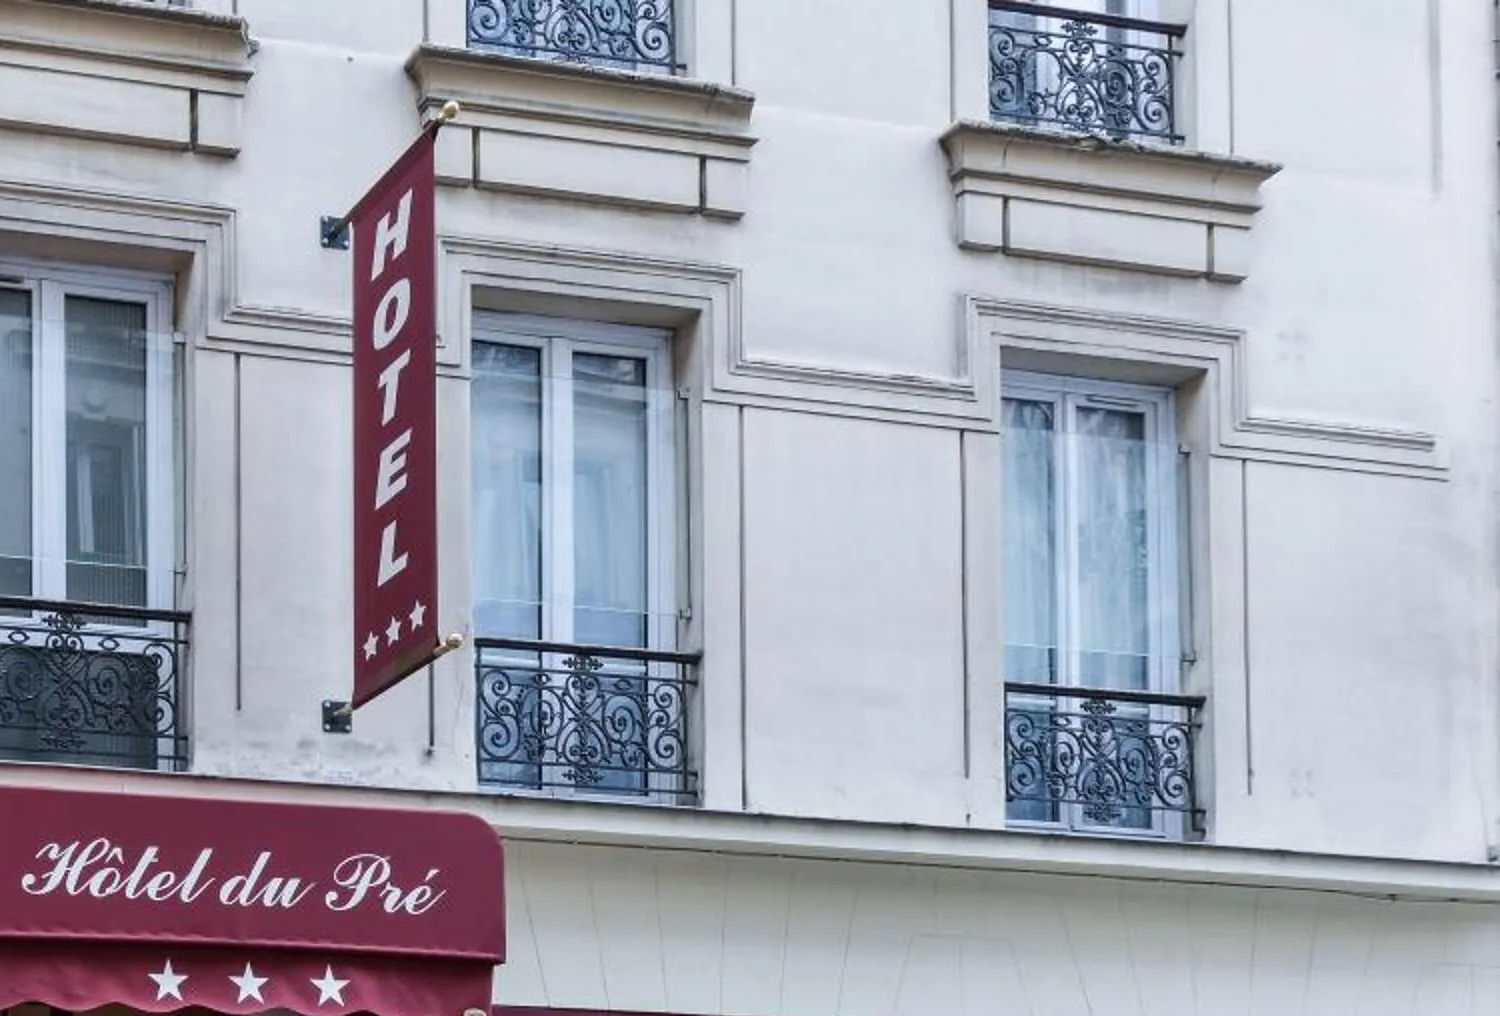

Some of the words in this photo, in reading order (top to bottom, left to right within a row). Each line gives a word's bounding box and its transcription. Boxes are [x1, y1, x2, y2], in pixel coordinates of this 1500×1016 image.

[371, 188, 413, 588] HOTEL
[21, 837, 216, 903] Hôtel
[219, 850, 316, 908] du
[324, 852, 448, 915] Pré
